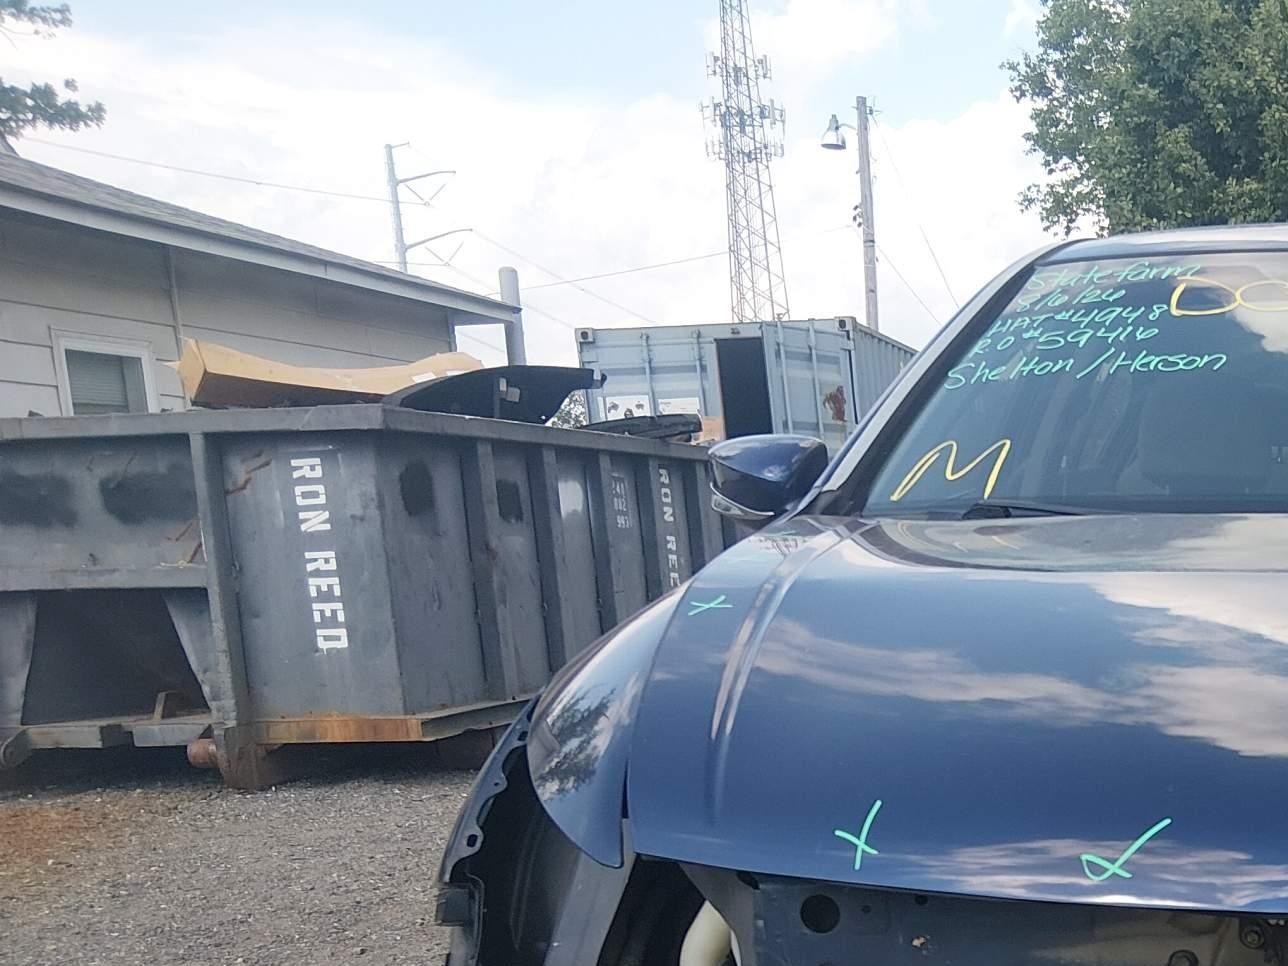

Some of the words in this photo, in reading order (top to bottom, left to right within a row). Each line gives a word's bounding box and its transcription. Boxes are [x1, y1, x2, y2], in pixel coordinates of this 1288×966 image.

[290, 457, 332, 532] RON
[890, 439, 1012, 502] M
[658, 468, 674, 523] RON
[666, 535, 681, 588] REE
[304, 551, 349, 650] REED
